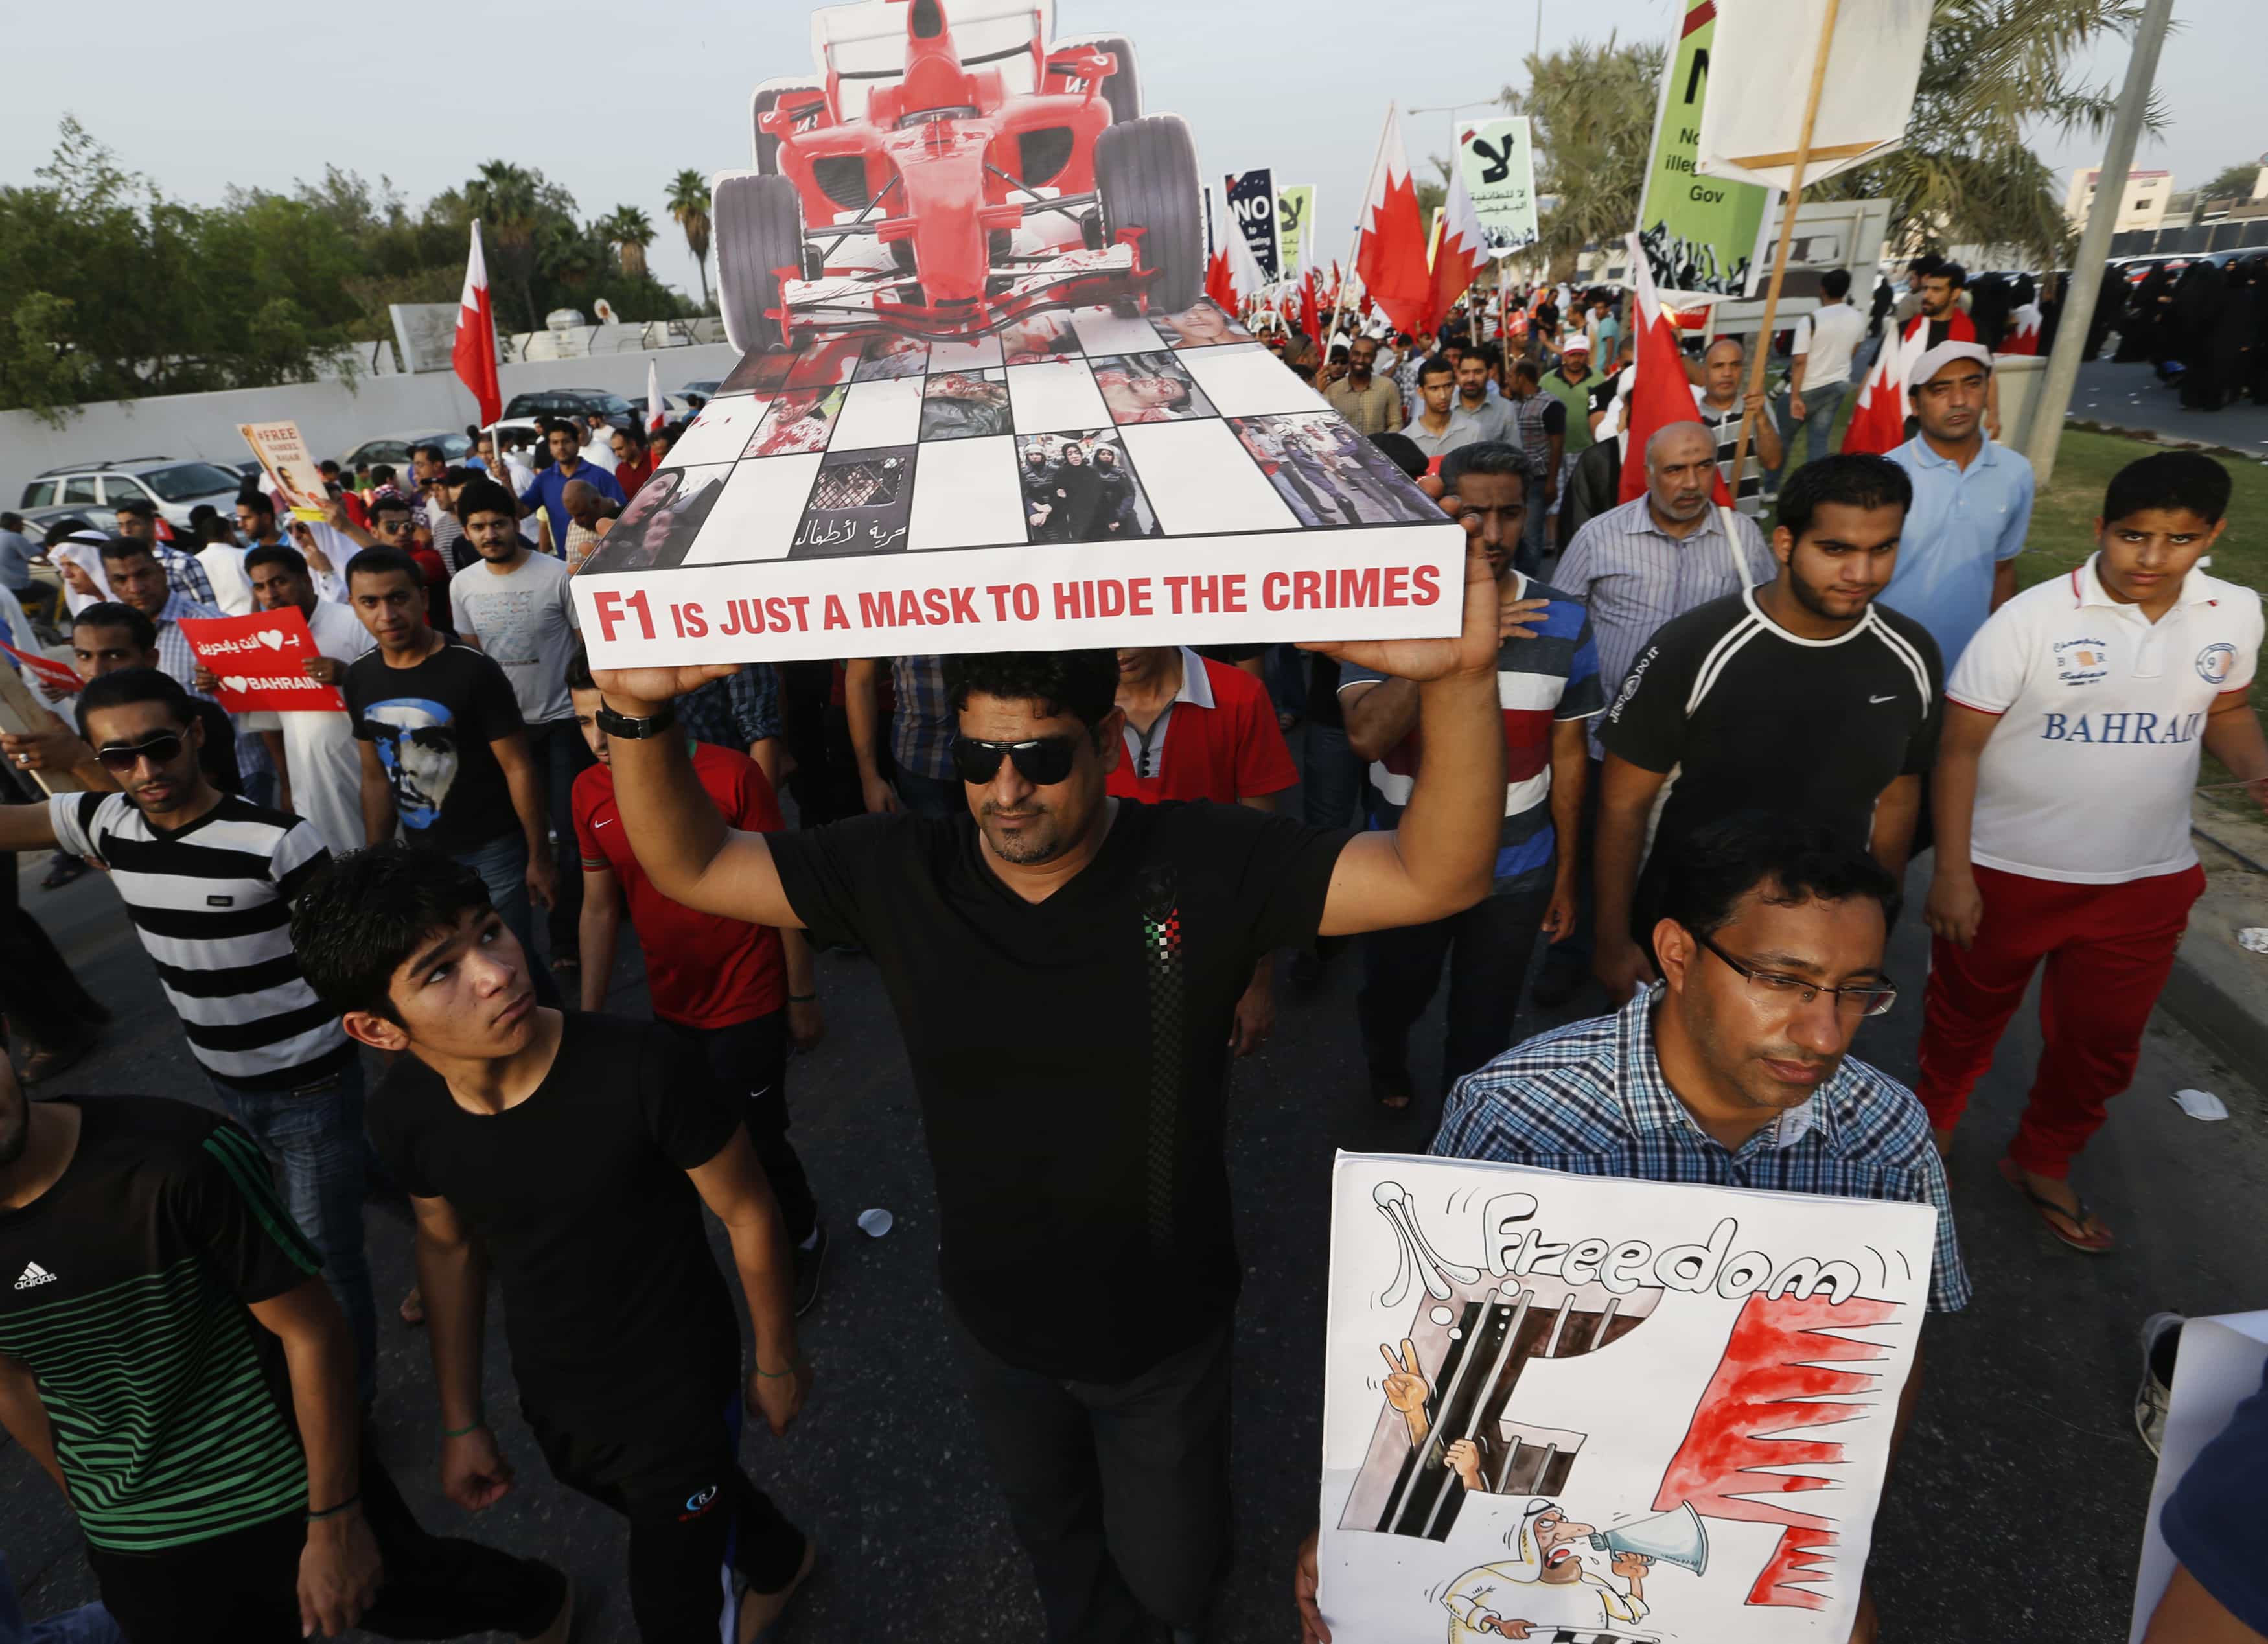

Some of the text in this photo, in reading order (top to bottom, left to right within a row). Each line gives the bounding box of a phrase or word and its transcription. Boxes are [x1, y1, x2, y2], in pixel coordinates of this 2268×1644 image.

[1472, 133, 1514, 184] لا
[1232, 196, 1270, 221] NO
[1689, 185, 1725, 203] Gov
[594, 565, 1439, 641] F1 IS JUST A MASK TO HIDE THE CRIMES
[247, 677, 323, 690] BAHRAIN
[1609, 647, 1659, 723] JUST DO IT
[1483, 1192, 1861, 1306] Freedom
[14, 1273, 57, 1290] adidas
